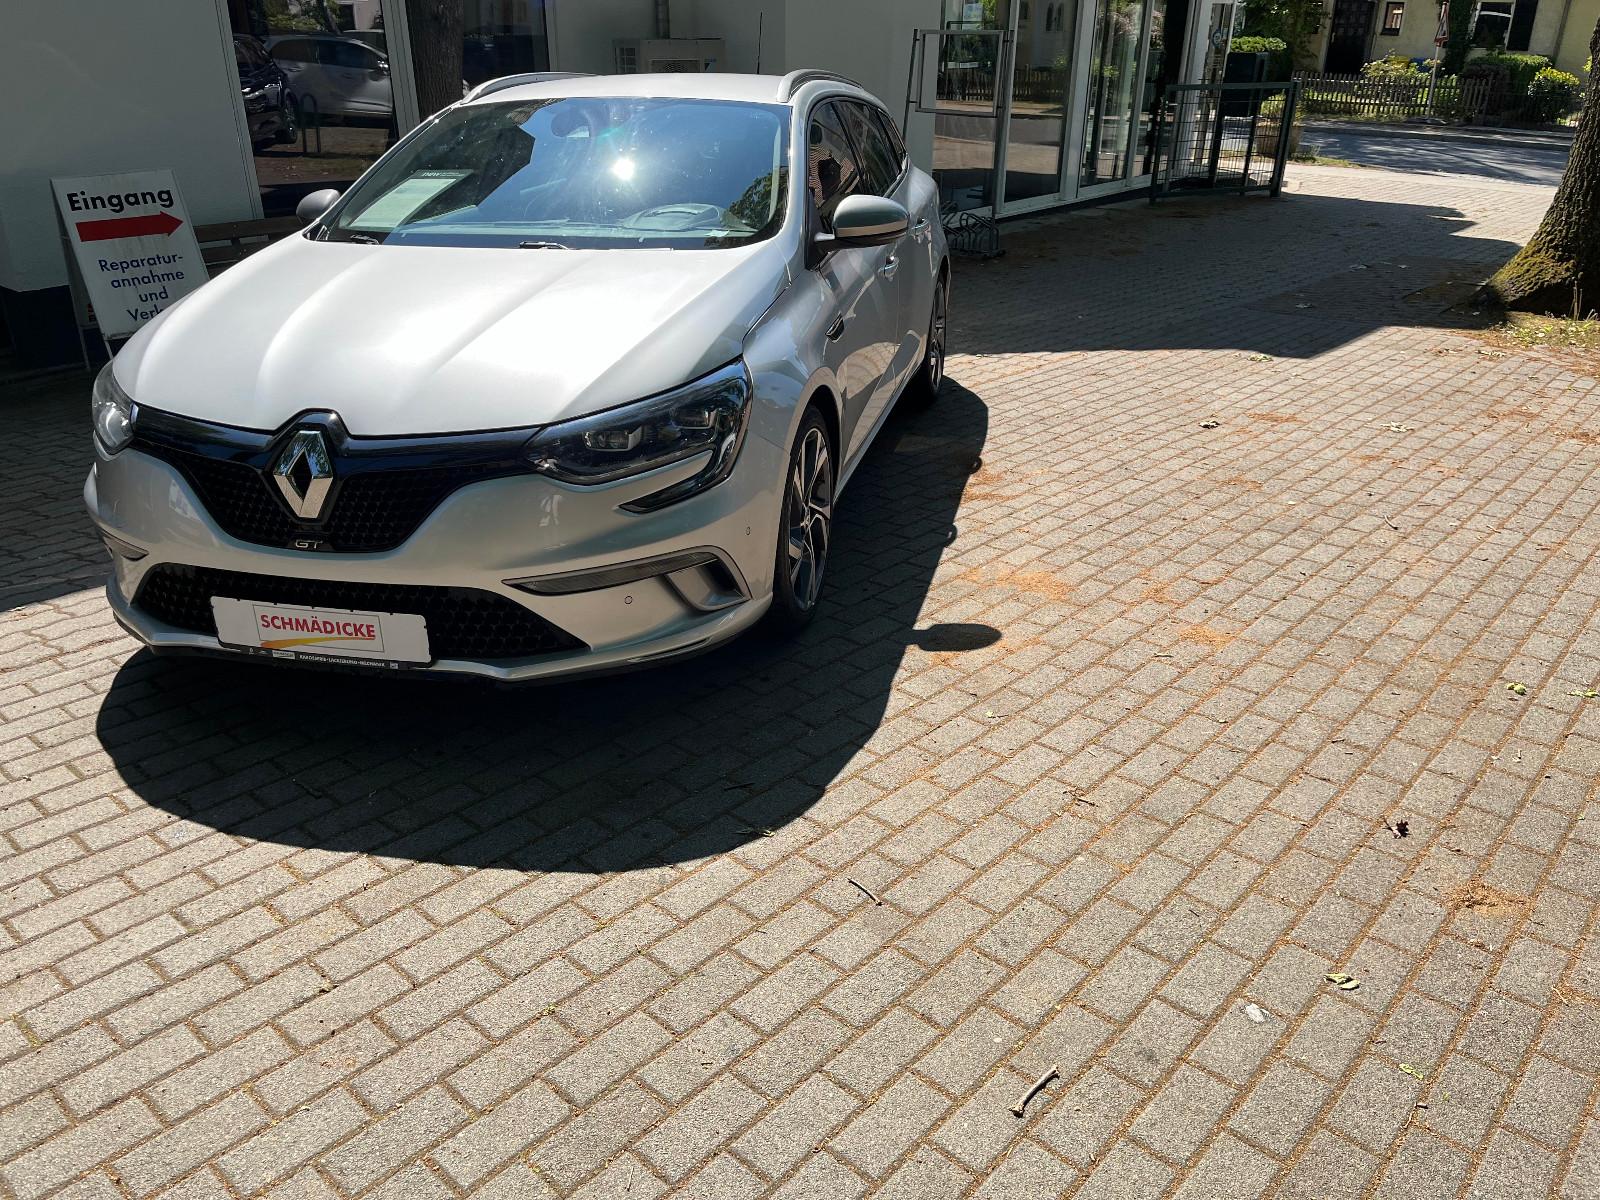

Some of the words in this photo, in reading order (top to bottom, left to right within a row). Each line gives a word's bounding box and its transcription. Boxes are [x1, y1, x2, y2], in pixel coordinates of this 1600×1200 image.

[66, 189, 174, 213] Eingang
[98, 253, 183, 273] Reparatur-
[110, 269, 185, 289] annahme
[138, 286, 169, 303] und
[295, 539, 324, 549] GT
[260, 614, 377, 638] SCHMÄDICKE
